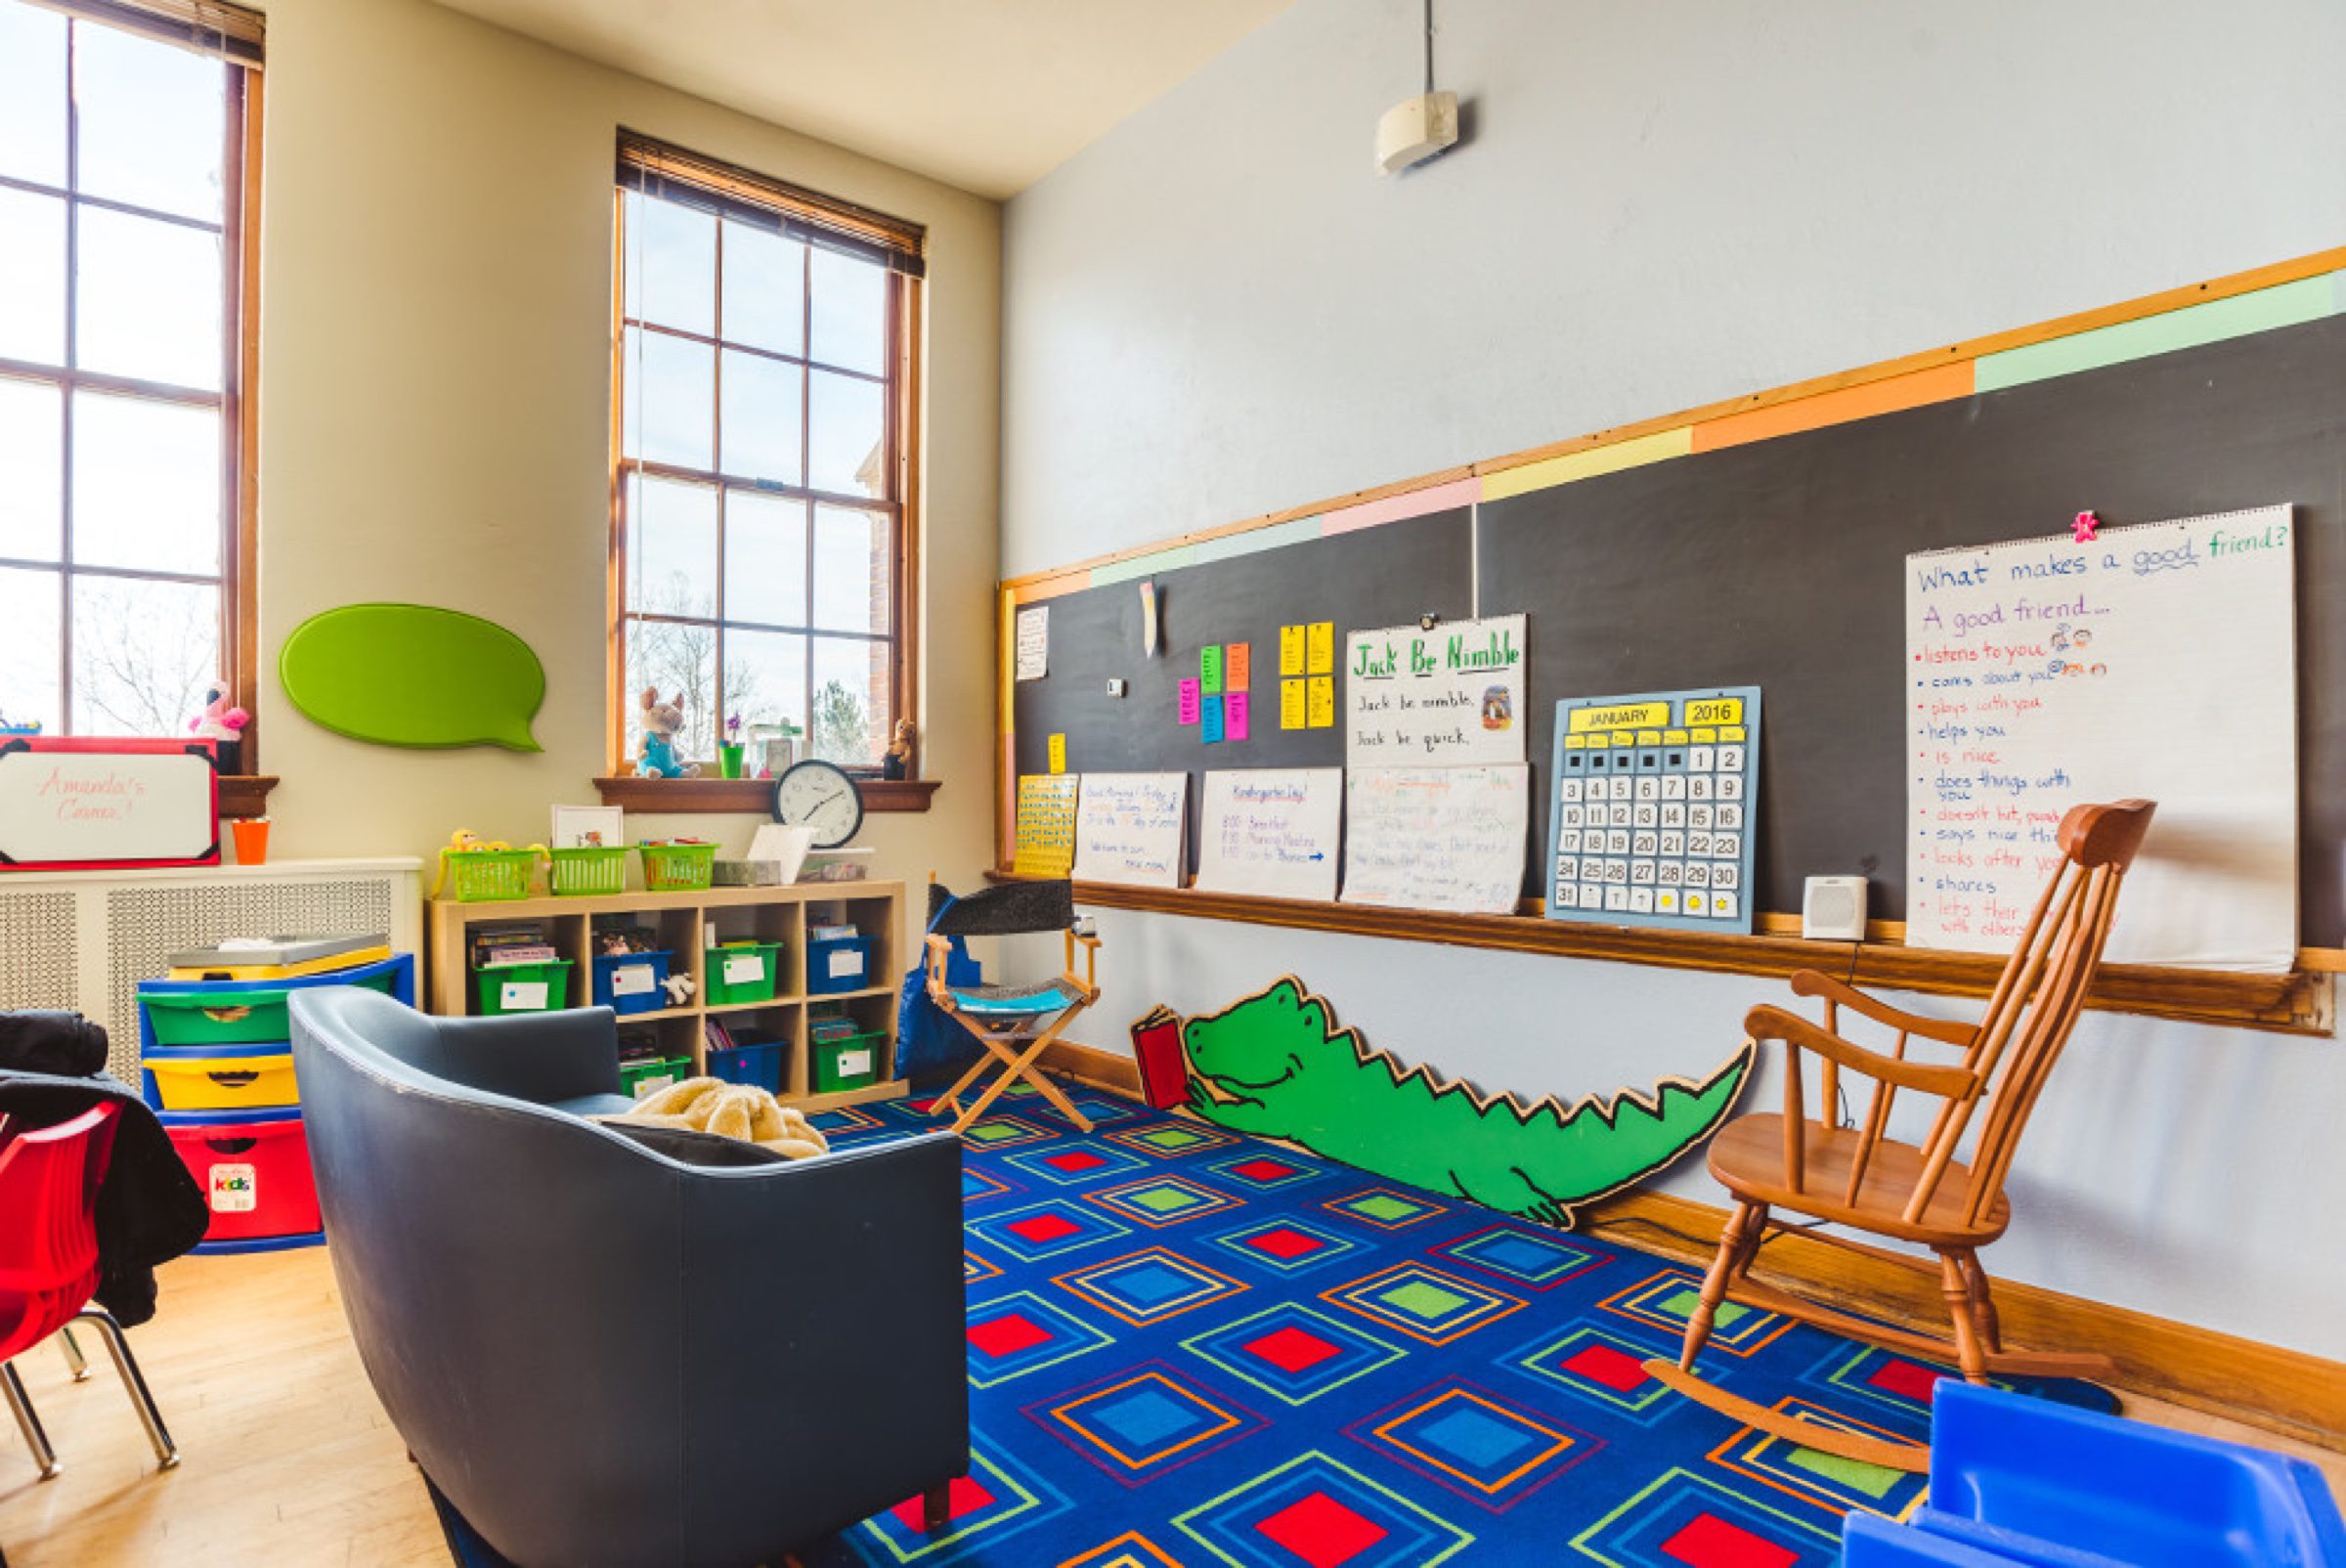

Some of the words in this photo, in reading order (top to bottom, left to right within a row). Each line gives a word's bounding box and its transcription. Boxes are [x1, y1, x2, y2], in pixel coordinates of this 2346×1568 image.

[1918, 559, 1989, 592] What
[2011, 552, 2088, 582] makes
[2102, 553, 2121, 570] a
[2133, 539, 2200, 575] good
[2208, 526, 2289, 558] friend?
[1923, 606, 1942, 632] A
[1954, 603, 2004, 636] good
[1354, 641, 1399, 676] Jack
[1411, 638, 1437, 673] Be
[1448, 629, 1519, 670] Nimble
[1925, 642, 1978, 664] listens
[1982, 641, 2002, 658] to
[2004, 643, 2049, 666] you
[1982, 671, 2021, 685] about
[2028, 671, 2056, 685] you
[1358, 693, 1390, 711] Jack
[1401, 693, 1415, 711] be
[1932, 697, 1969, 720] plays
[1977, 692, 2009, 712] with
[2012, 697, 2044, 718] you
[1588, 710, 1649, 727] JANUARY
[1692, 698, 1731, 721] 2016
[1356, 730, 1386, 746] Jack
[1395, 729, 1412, 745] be
[1928, 721, 1969, 745] helps
[1975, 724, 2006, 742] you
[1696, 753, 1703, 767] 1
[1724, 752, 1736, 767] 2
[1935, 751, 1950, 764] is
[1962, 748, 2002, 764] nice
[40, 767, 146, 797] Amanda's
[1567, 784, 1576, 798] 3
[1590, 782, 1600, 797] 4
[1616, 782, 1626, 797] 5
[1642, 782, 1651, 797] 6
[1668, 780, 1677, 796] 7
[1694, 780, 1704, 797] 8
[1723, 780, 1734, 797] 9
[1934, 769, 1973, 788] does
[1977, 769, 2027, 796] things
[2035, 768, 2072, 789] with
[1938, 791, 1972, 802] you
[1567, 809, 1580, 824] 10
[1590, 809, 1601, 824] 11
[1613, 808, 1626, 824] 12
[1637, 808, 1651, 824] 13
[1665, 808, 1679, 824] 14
[1692, 809, 1707, 825] 15
[1719, 808, 1734, 824] 16
[1565, 834, 1577, 849] 17
[1588, 835, 1601, 849] 18
[1612, 835, 1626, 849] 19
[1636, 836, 1655, 851] 20
[1664, 836, 1680, 852] 21
[1689, 837, 1710, 852] 22
[1716, 839, 1736, 854] 23
[1936, 828, 1976, 846] says
[1987, 828, 2019, 842] nice
[1933, 847, 1973, 868] looks
[1983, 848, 2022, 868] after
[1558, 860, 1574, 876] 24
[1584, 863, 1602, 878] 25
[1607, 864, 1625, 880] 26
[1634, 864, 1653, 881] 27
[1661, 865, 1679, 882] 28
[1687, 866, 1707, 883] 29
[1716, 868, 1734, 885] 30
[1558, 887, 1574, 901] 31
[1935, 875, 1997, 893] shares
[1938, 893, 1971, 918] lets
[1983, 896, 2020, 920] their
[1941, 917, 1971, 934] with
